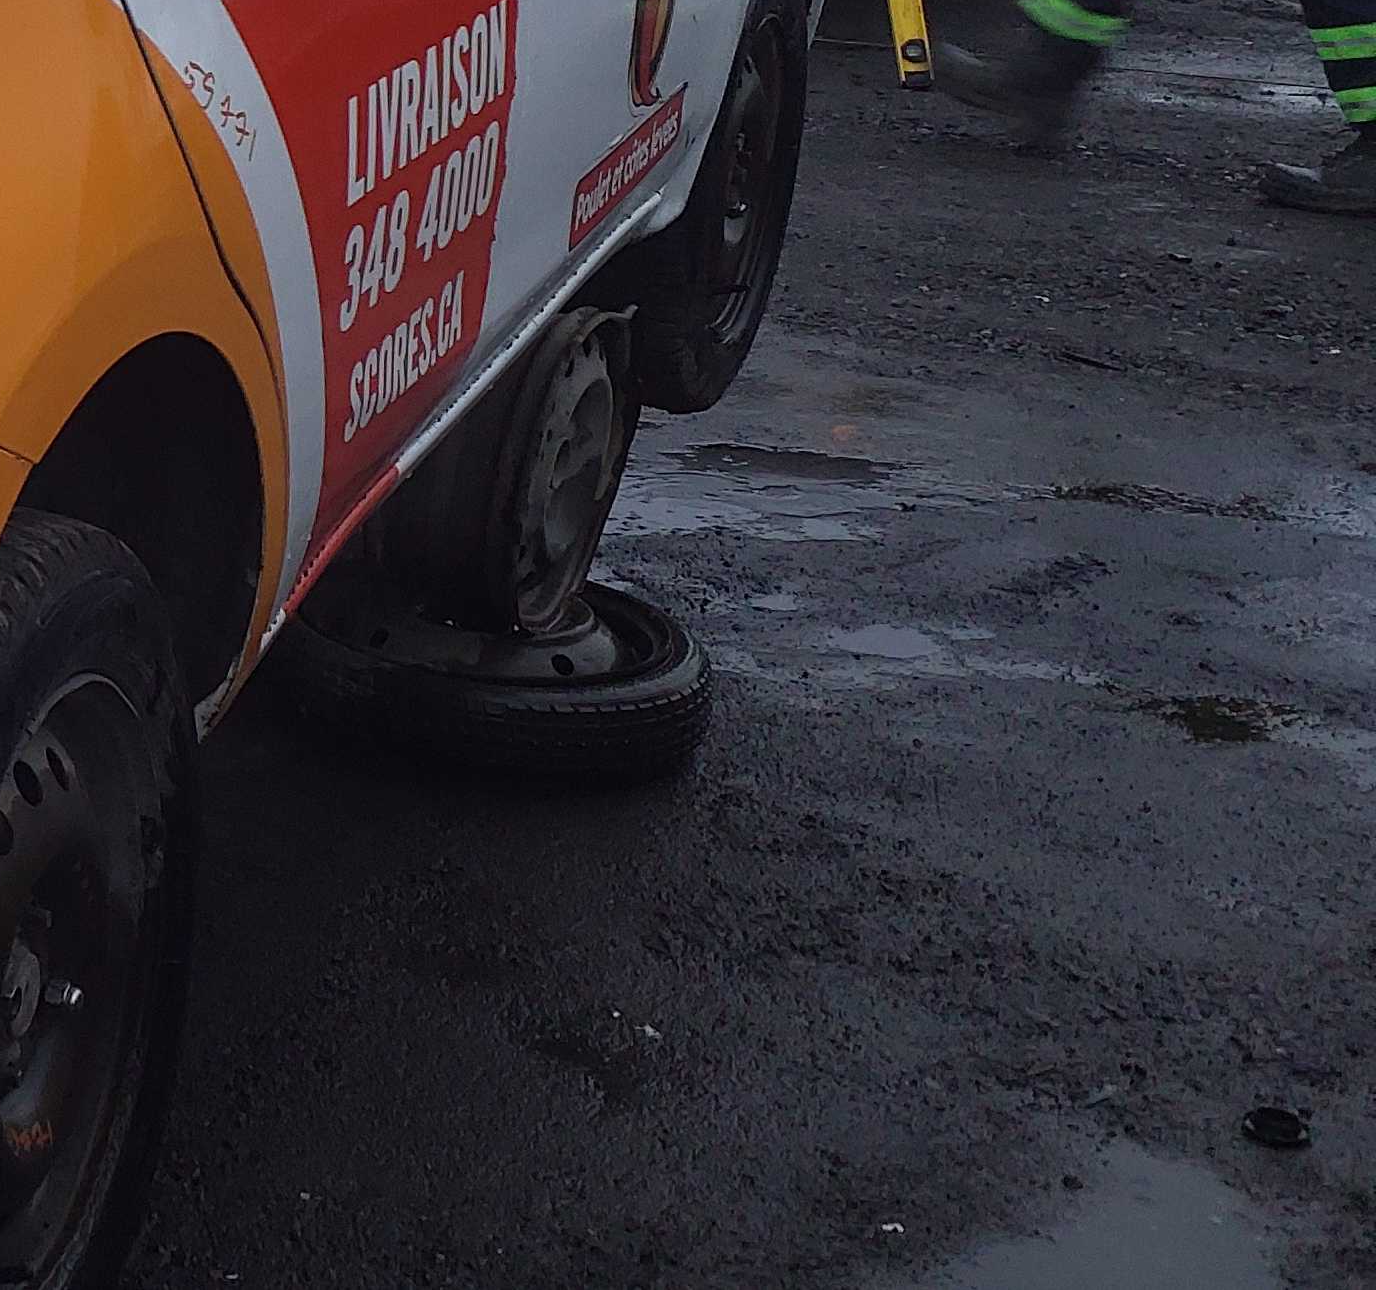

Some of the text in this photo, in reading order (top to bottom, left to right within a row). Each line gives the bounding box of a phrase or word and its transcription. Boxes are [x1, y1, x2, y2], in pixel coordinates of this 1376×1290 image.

[340, 120, 500, 332] 348 4000
[344, 270, 465, 443] SCORES.CA
